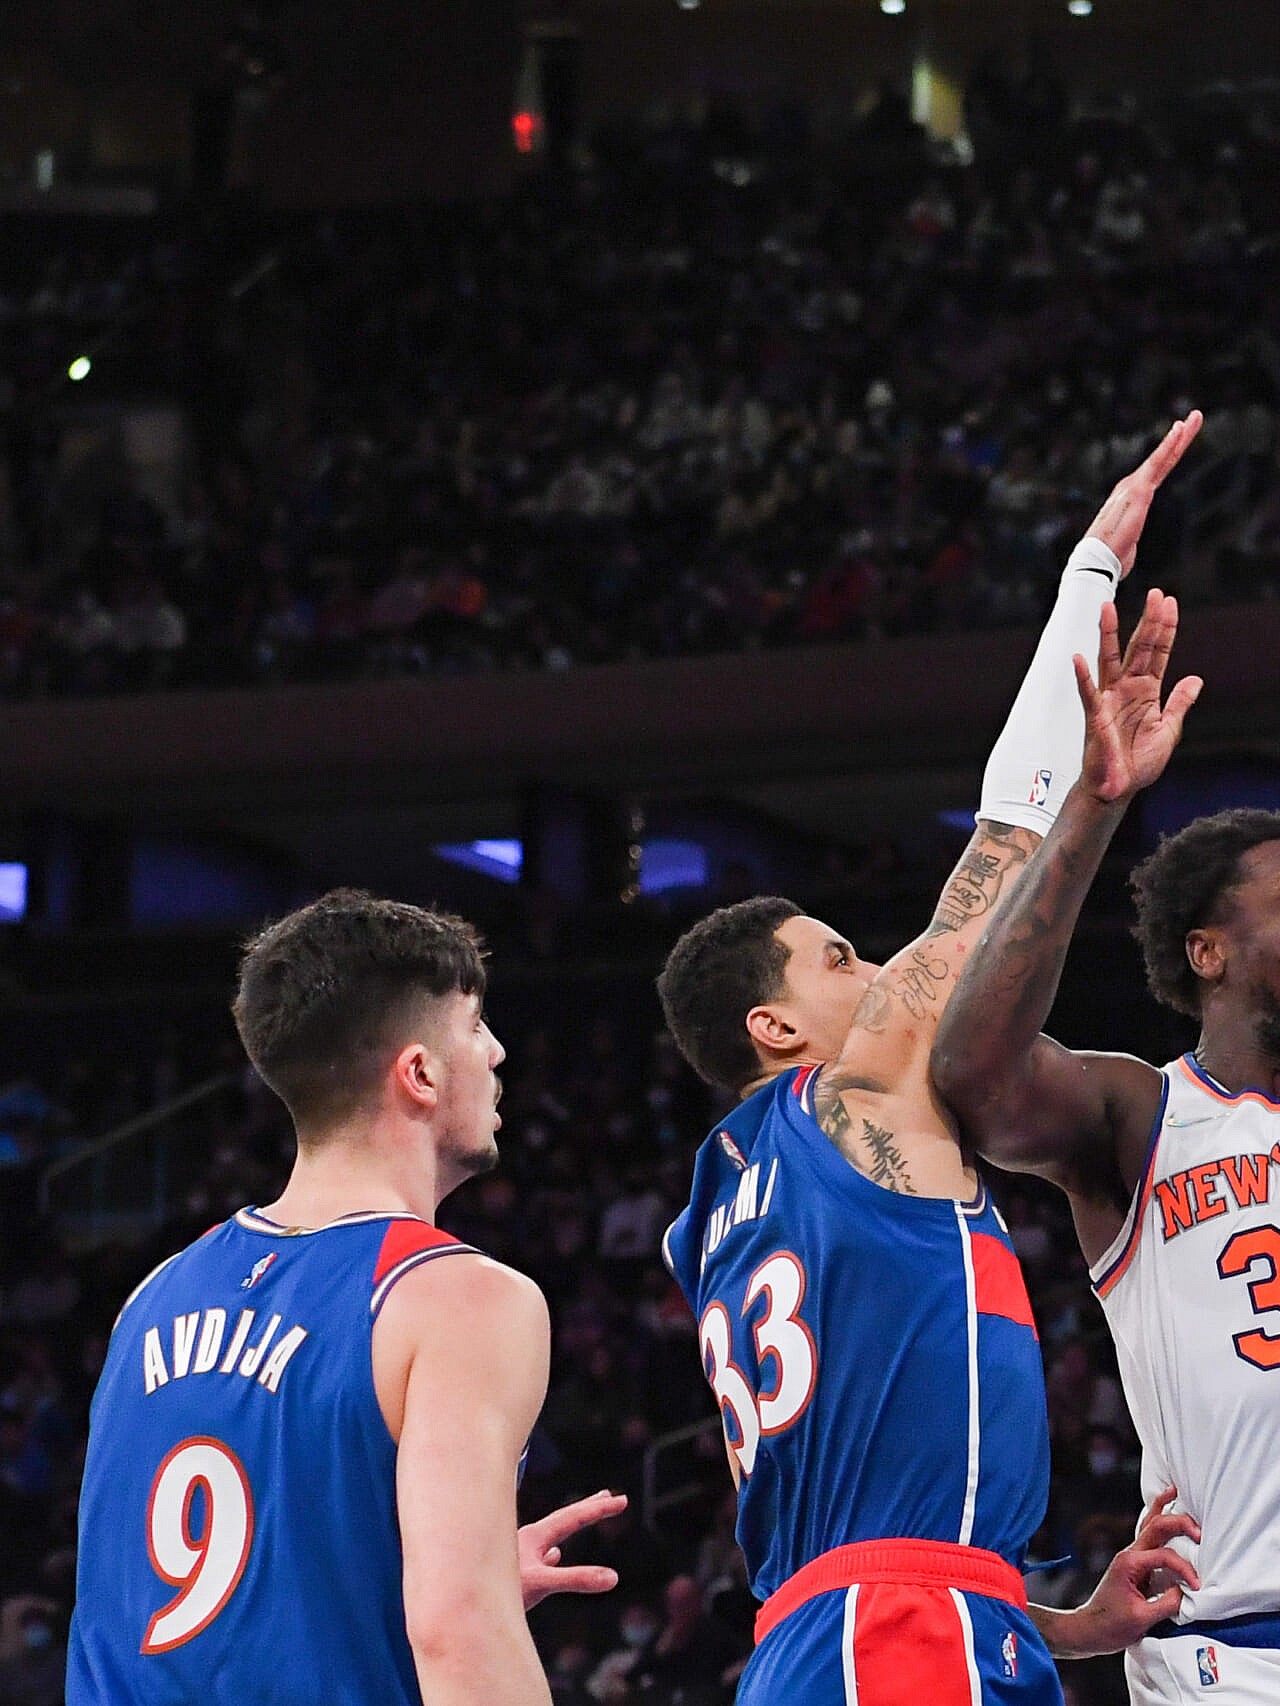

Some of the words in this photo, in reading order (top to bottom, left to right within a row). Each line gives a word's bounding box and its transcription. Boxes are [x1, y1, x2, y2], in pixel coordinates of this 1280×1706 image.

[1154, 1153, 1271, 1243] NEW
[143, 1307, 309, 1395] AVDIJA
[699, 1249, 817, 1479] 33
[139, 1435, 255, 1655] 9
